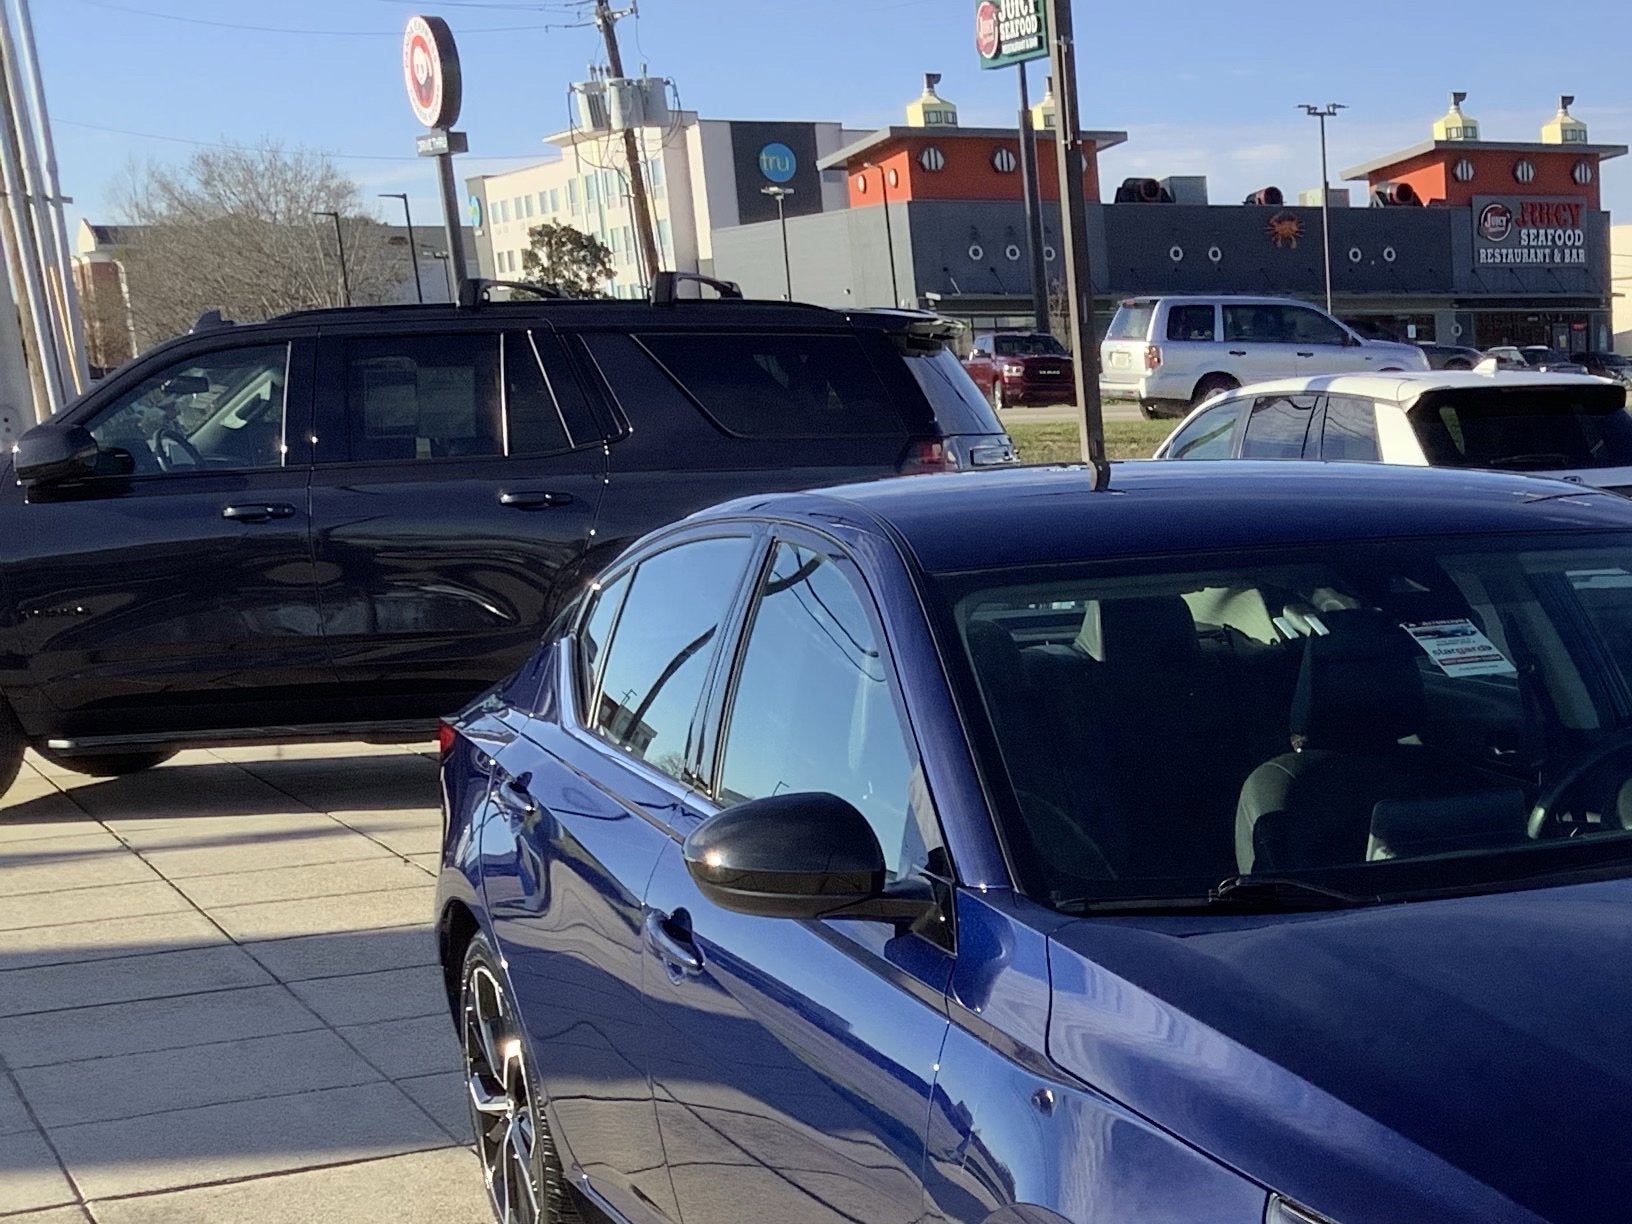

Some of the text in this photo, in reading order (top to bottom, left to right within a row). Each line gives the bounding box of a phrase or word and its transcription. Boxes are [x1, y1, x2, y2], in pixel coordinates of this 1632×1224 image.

[999, 14, 1038, 41] SEAFOOD
[760, 152, 789, 171] tru
[1515, 202, 1580, 228] JUICY
[1520, 229, 1584, 246] SEAFOOD
[1480, 249, 1586, 263] RESTAURANT & BAR
